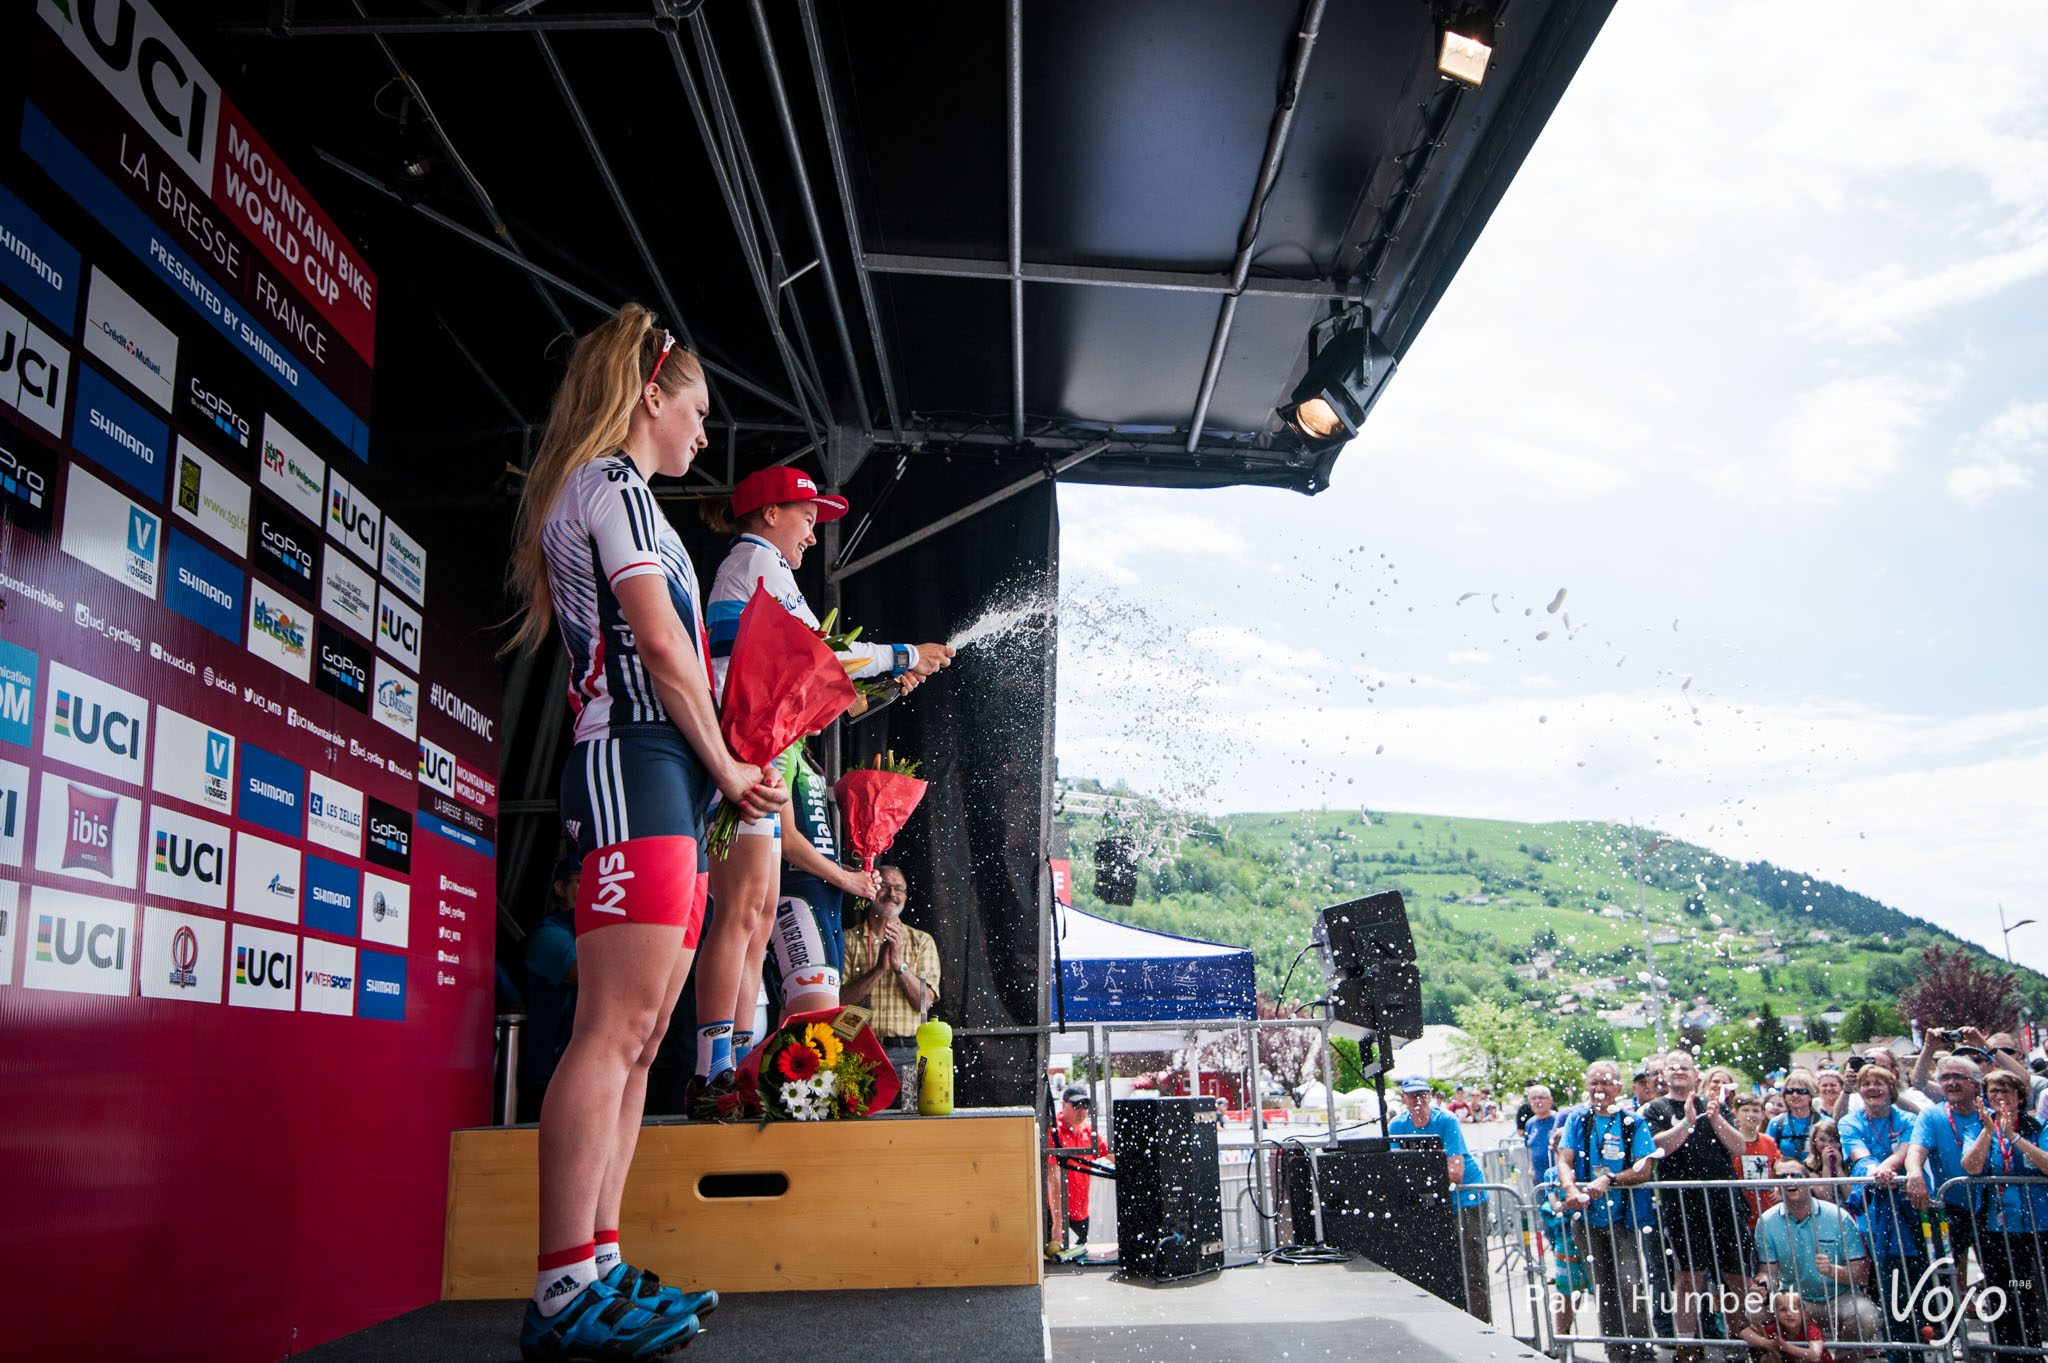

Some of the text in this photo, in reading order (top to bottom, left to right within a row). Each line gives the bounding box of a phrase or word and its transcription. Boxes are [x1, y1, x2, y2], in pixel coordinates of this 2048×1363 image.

[225, 162, 339, 305] WORLD CUP
[228, 123, 372, 310] MOUNTAIN BIKE
[120, 133, 326, 364] LA BRESSE FRANCE
[151, 238, 298, 387] PRESENTED BY SHIMANO
[103, 321, 161, 375] Crédit Mutuel
[191, 377, 250, 436] GoPro
[90, 408, 154, 465] SHIMANO
[261, 521, 312, 567] GoPro
[341, 495, 376, 551] UCI
[126, 562, 153, 586] VOSGES
[179, 567, 233, 610] SHIMANO
[253, 606, 305, 649] BRESSE
[389, 609, 418, 657] UCI
[90, 615, 141, 652] uci_cycling
[163, 650, 196, 676] tv.uci.ch
[215, 676, 237, 696] uci.ch
[253, 692, 282, 716] UCI_MTB
[322, 645, 365, 682] GoPro
[73, 695, 140, 761] UCI
[431, 682, 493, 742] #UCIMTBWC
[205, 784, 228, 801] VOSGES
[249, 777, 295, 807] SHIMANO
[425, 748, 453, 789] UCI
[73, 809, 108, 848] ibis
[326, 803, 361, 828] LES ZELLES
[371, 818, 408, 845] GoPro
[169, 833, 224, 886] UCI
[313, 886, 351, 909] SHIMANO
[591, 851, 635, 917] sky
[55, 917, 127, 971] UCI
[779, 913, 810, 969] VAN DER HEIDE
[248, 947, 292, 990] UCI
[313, 971, 352, 991] INTERSPORT
[366, 978, 400, 996] SHIMANO
